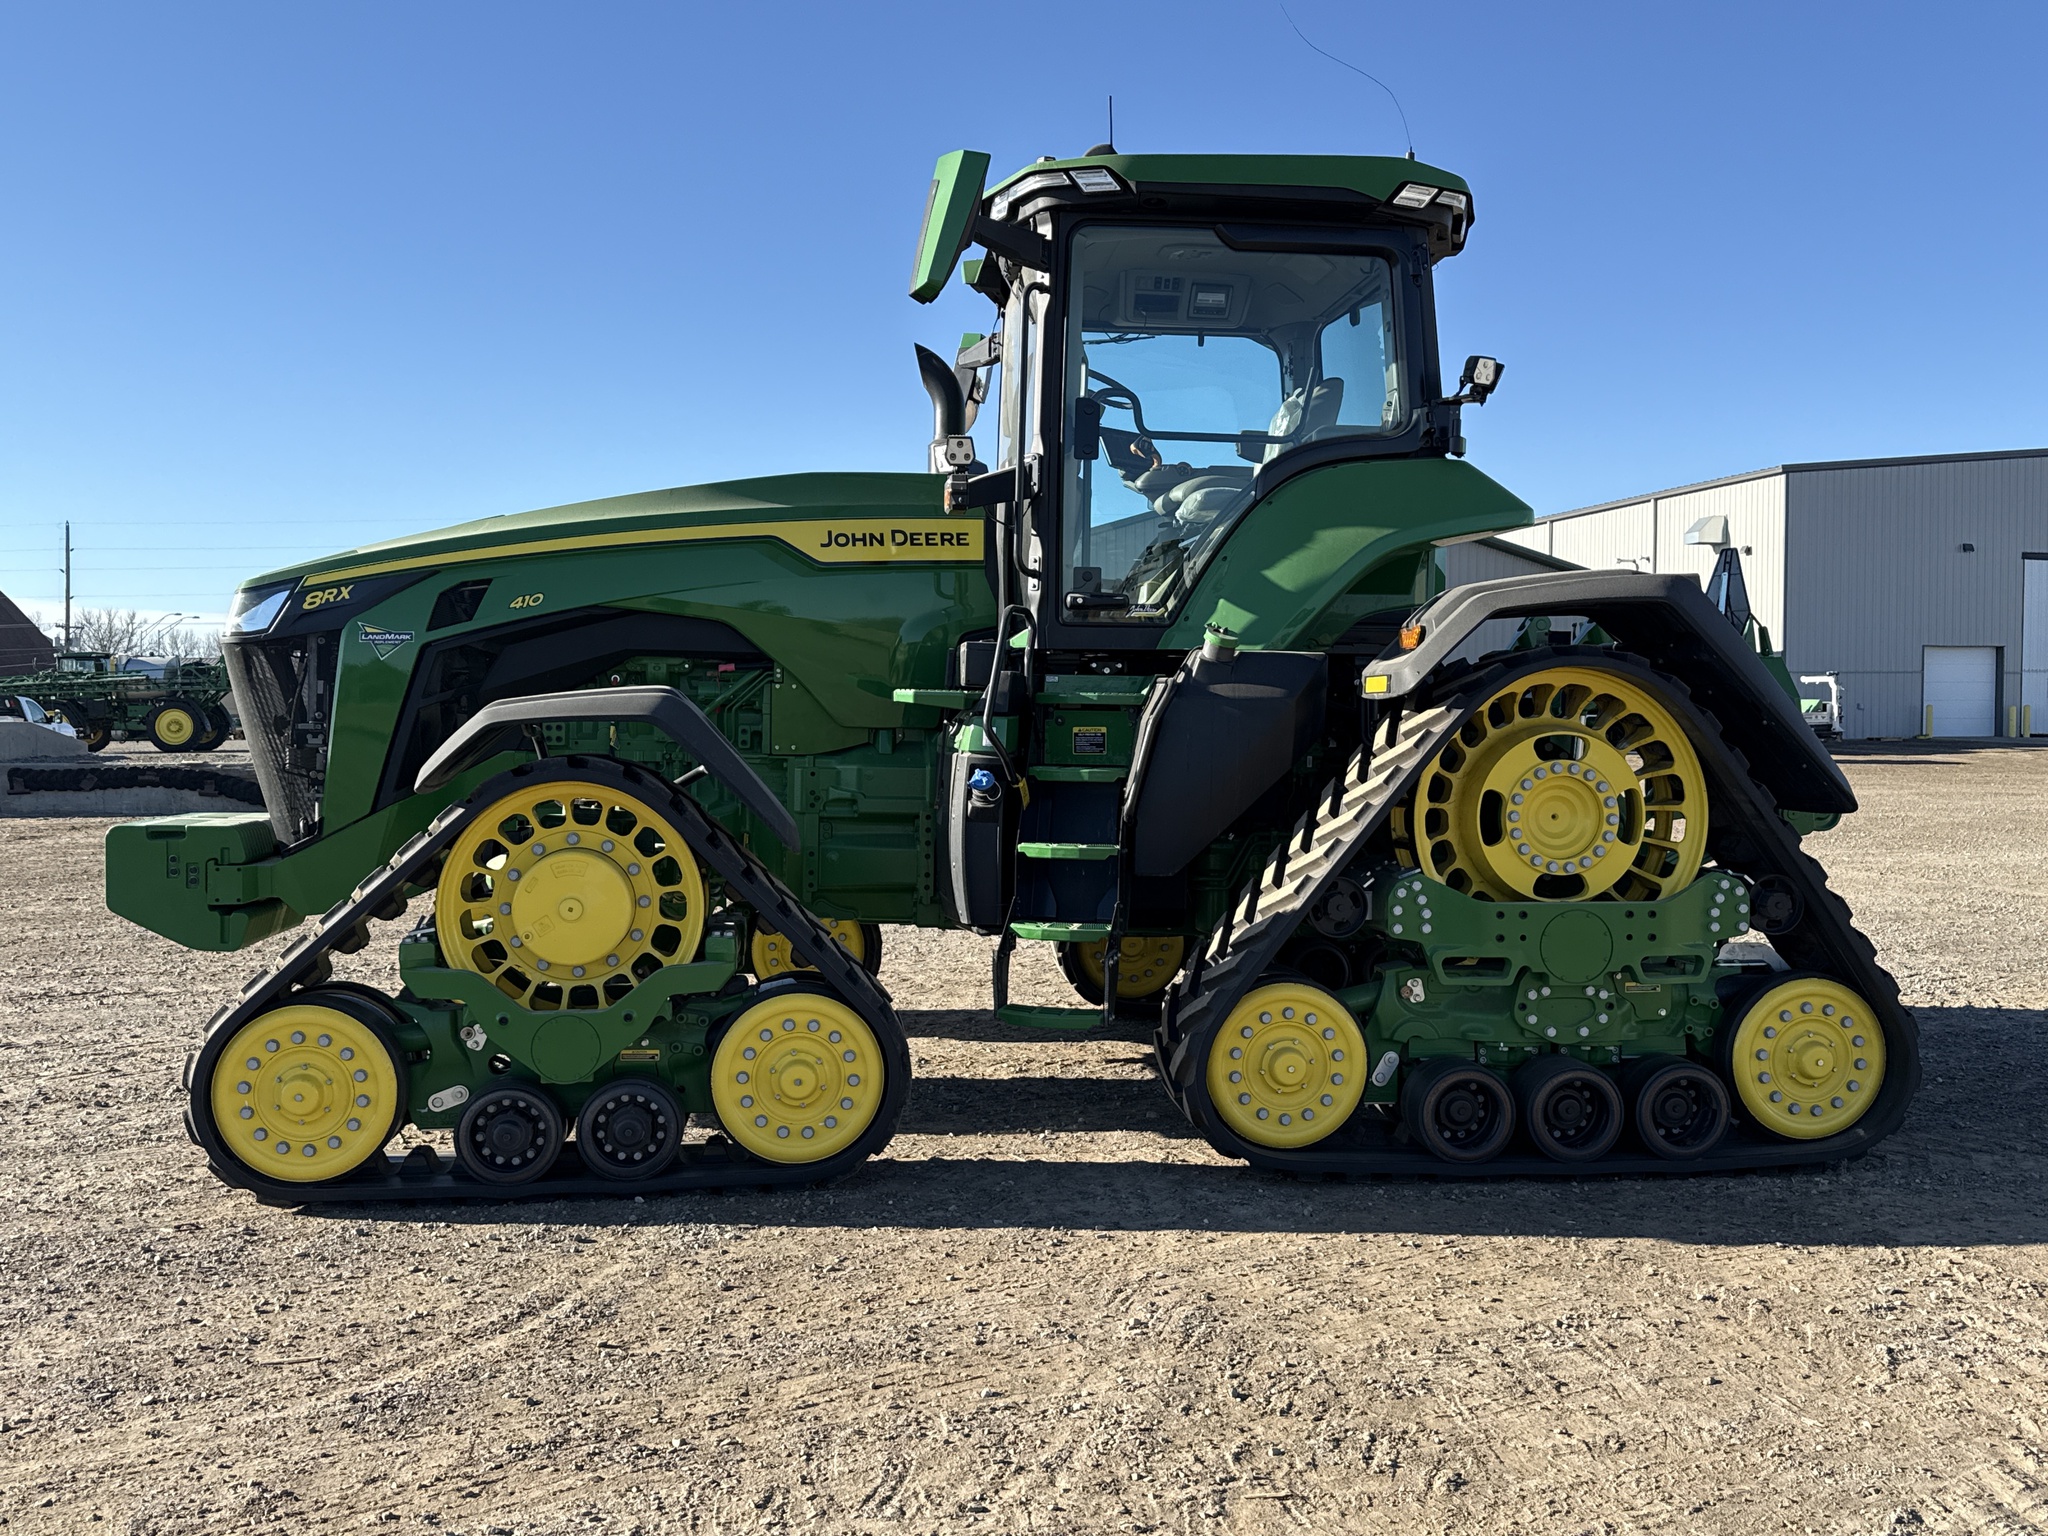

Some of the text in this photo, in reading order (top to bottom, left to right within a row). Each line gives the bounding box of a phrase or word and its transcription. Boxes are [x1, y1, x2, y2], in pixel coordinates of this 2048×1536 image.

[820, 529, 970, 548] JOHN DEERE
[302, 584, 355, 610] 8RX
[509, 592, 544, 609] 410
